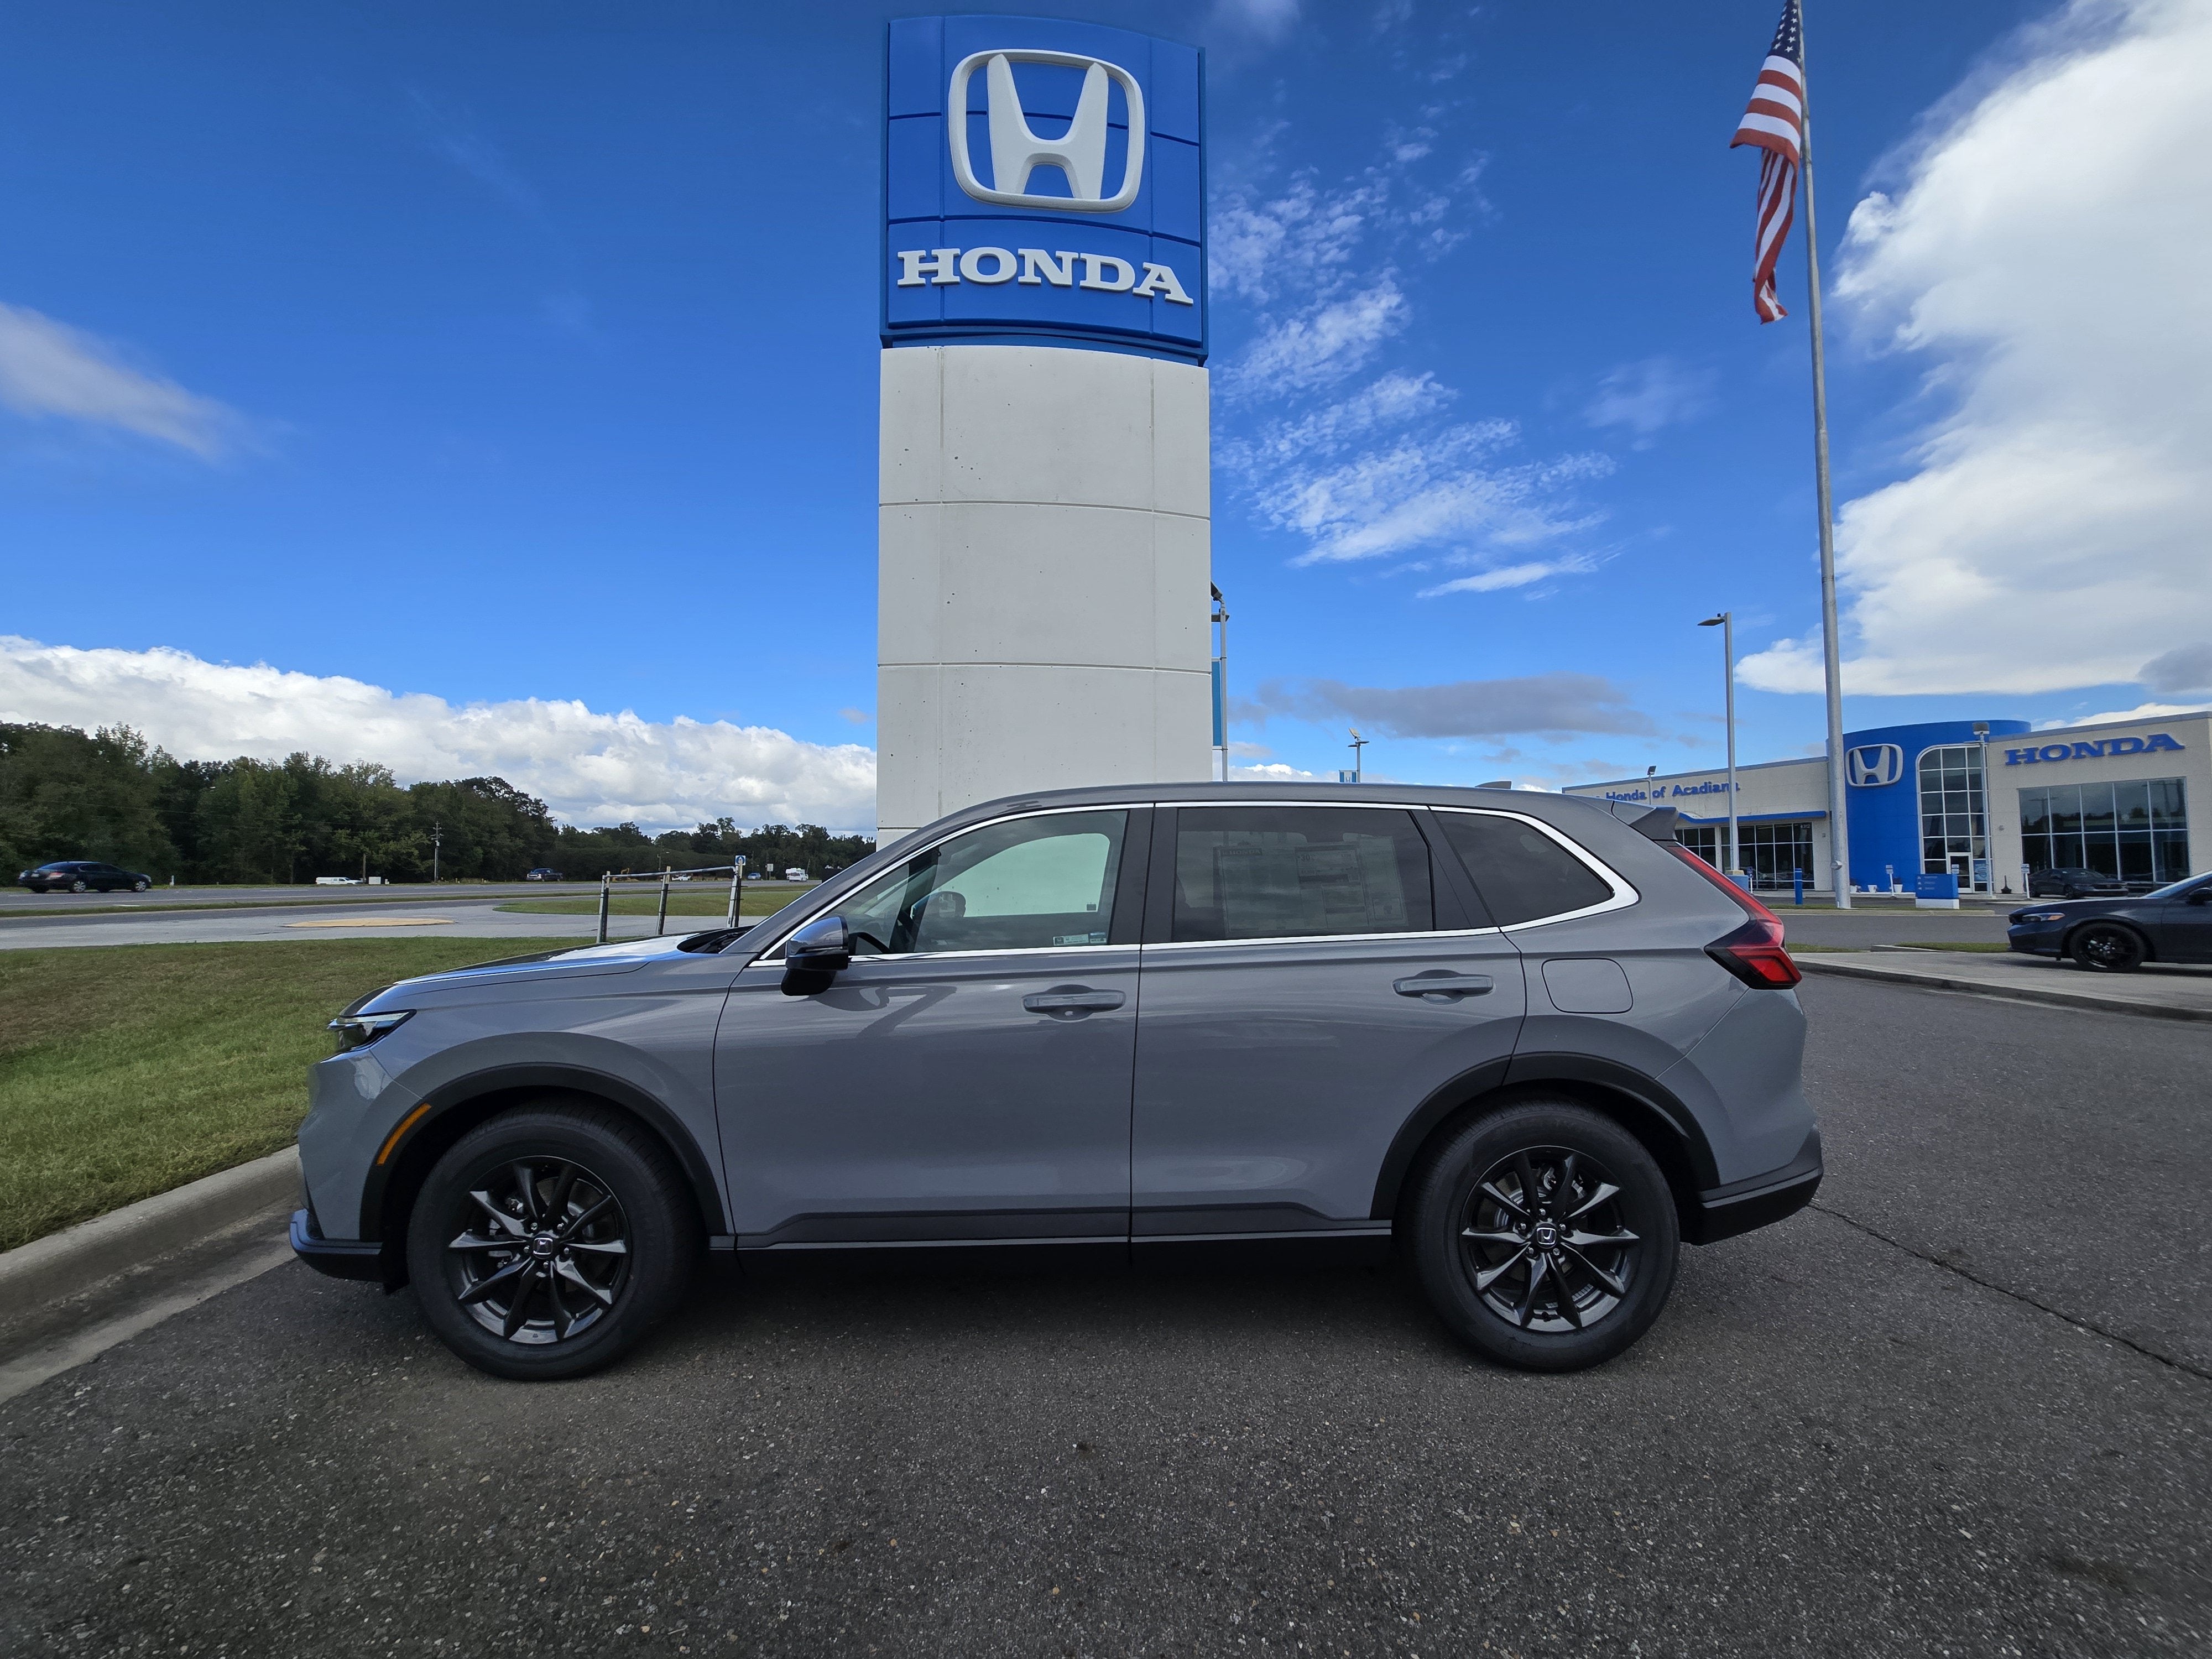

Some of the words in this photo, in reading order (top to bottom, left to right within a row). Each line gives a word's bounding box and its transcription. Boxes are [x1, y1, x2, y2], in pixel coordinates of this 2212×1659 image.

[897, 247, 1193, 306] HONDA
[2005, 733, 2185, 765] HONDA
[1606, 789, 1647, 801] Honda
[1652, 786, 1666, 798] of
